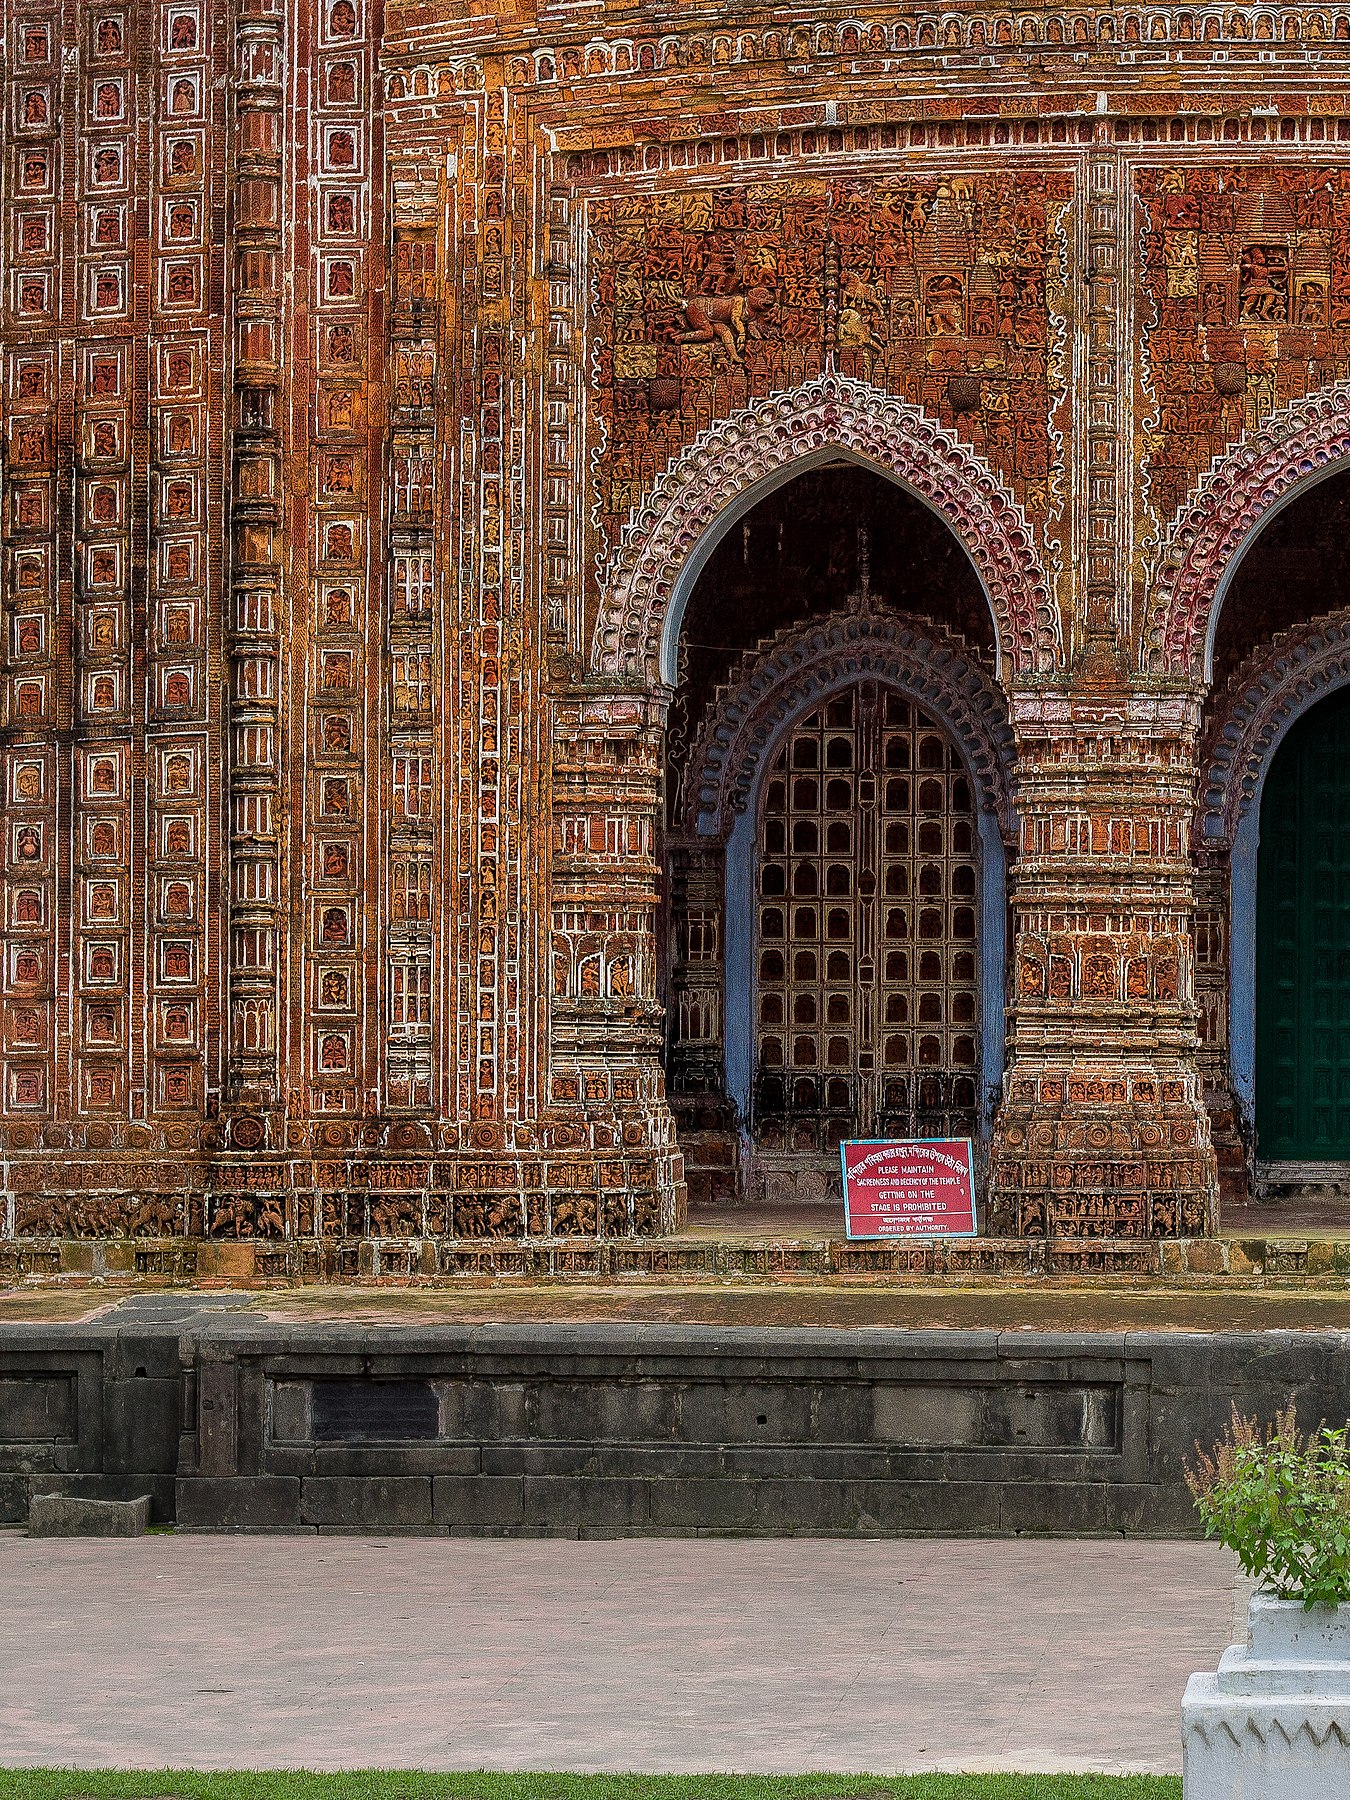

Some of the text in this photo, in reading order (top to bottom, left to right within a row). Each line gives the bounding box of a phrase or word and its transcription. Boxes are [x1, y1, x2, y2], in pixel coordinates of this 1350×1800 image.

[878, 1166, 934, 1174] PLEASE MAINTAIN
[857, 1178, 889, 1186] SACREDNESS
[890, 1178, 900, 1186] AND
[879, 1191, 905, 1199] GETTING
[920, 1190, 935, 1198] THE
[871, 1204, 890, 1212] STAGE
[903, 1202, 946, 1210] PROHIBITED
